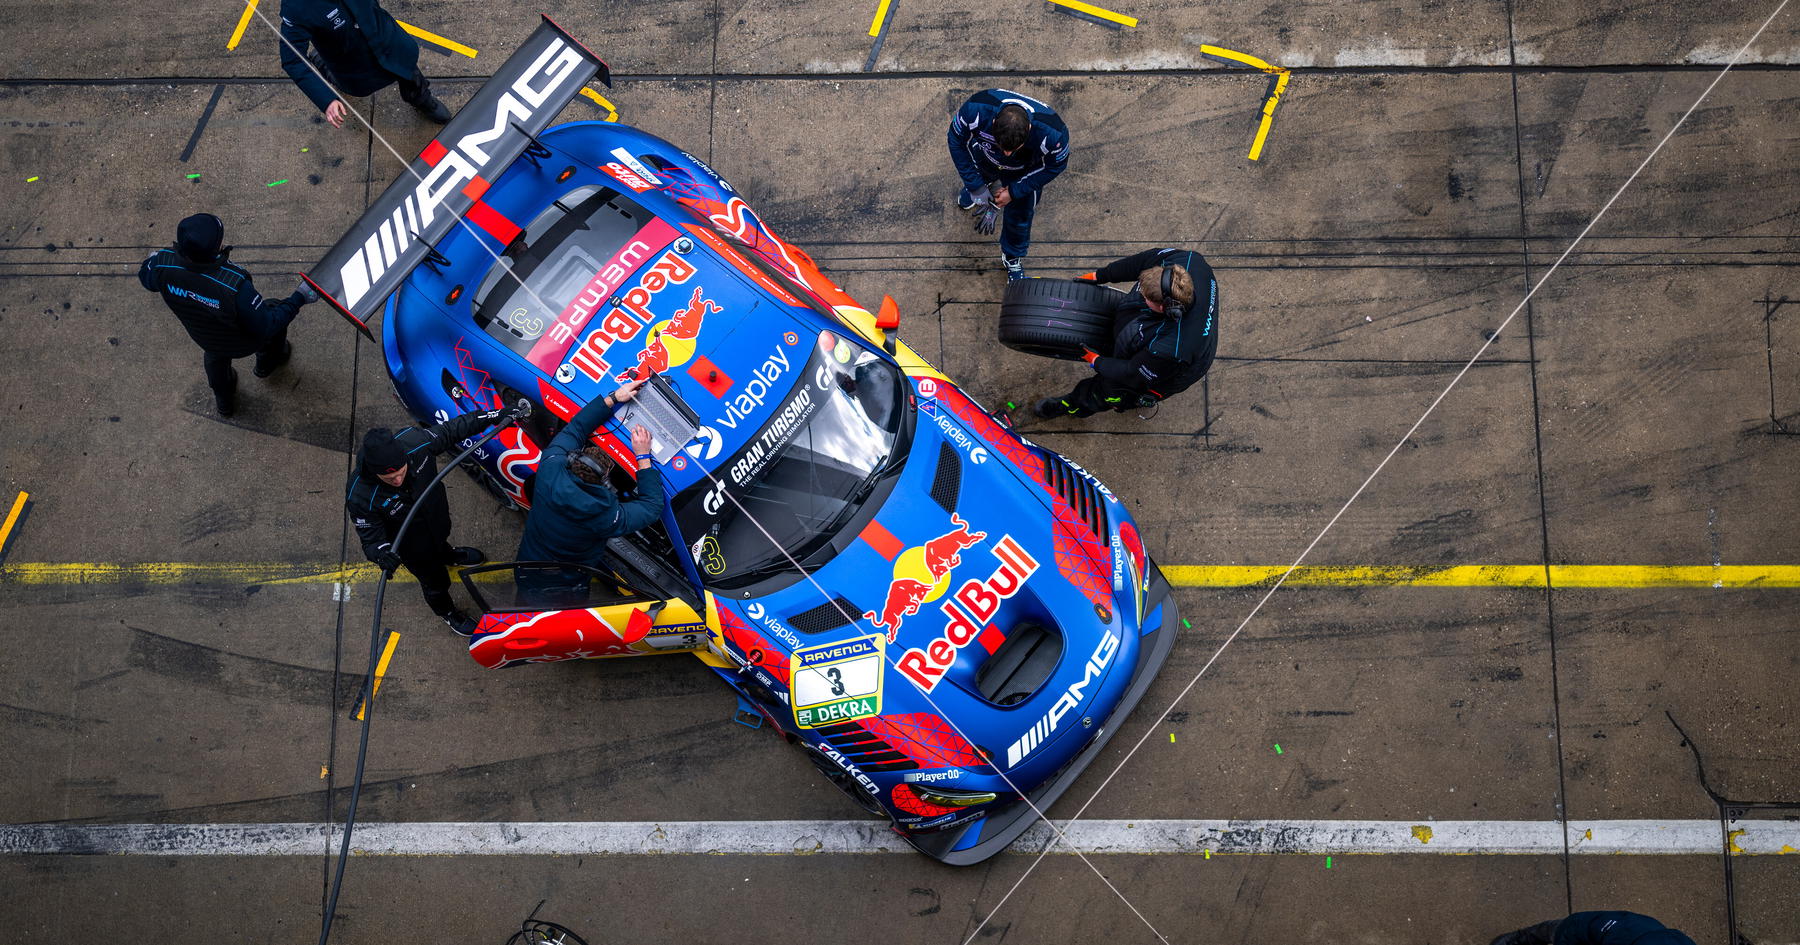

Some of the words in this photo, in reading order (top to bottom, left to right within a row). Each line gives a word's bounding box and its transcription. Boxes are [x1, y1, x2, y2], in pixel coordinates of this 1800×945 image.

[606, 162, 651, 188] auto
[682, 152, 718, 179] viaplay
[548, 241, 650, 346] WEMPE
[510, 307, 543, 335] 3
[716, 344, 791, 430] viaplay
[739, 473, 753, 488] THE
[751, 456, 767, 476] REAL
[766, 435, 789, 462] DRIVING
[786, 402, 816, 439] SIMULATOR
[934, 415, 972, 451] viaplay
[730, 441, 765, 484] GRAN
[701, 536, 727, 576] 3
[1114, 547, 1124, 580] Player
[682, 634, 697, 645] 3
[764, 615, 805, 650] viaplay
[805, 642, 872, 663] RAVENOL
[827, 667, 845, 696] 3
[1049, 630, 1119, 732] AMG
[818, 700, 873, 722] DEKRA
[818, 742, 881, 794] FALKEN
[915, 772, 947, 783] Player
